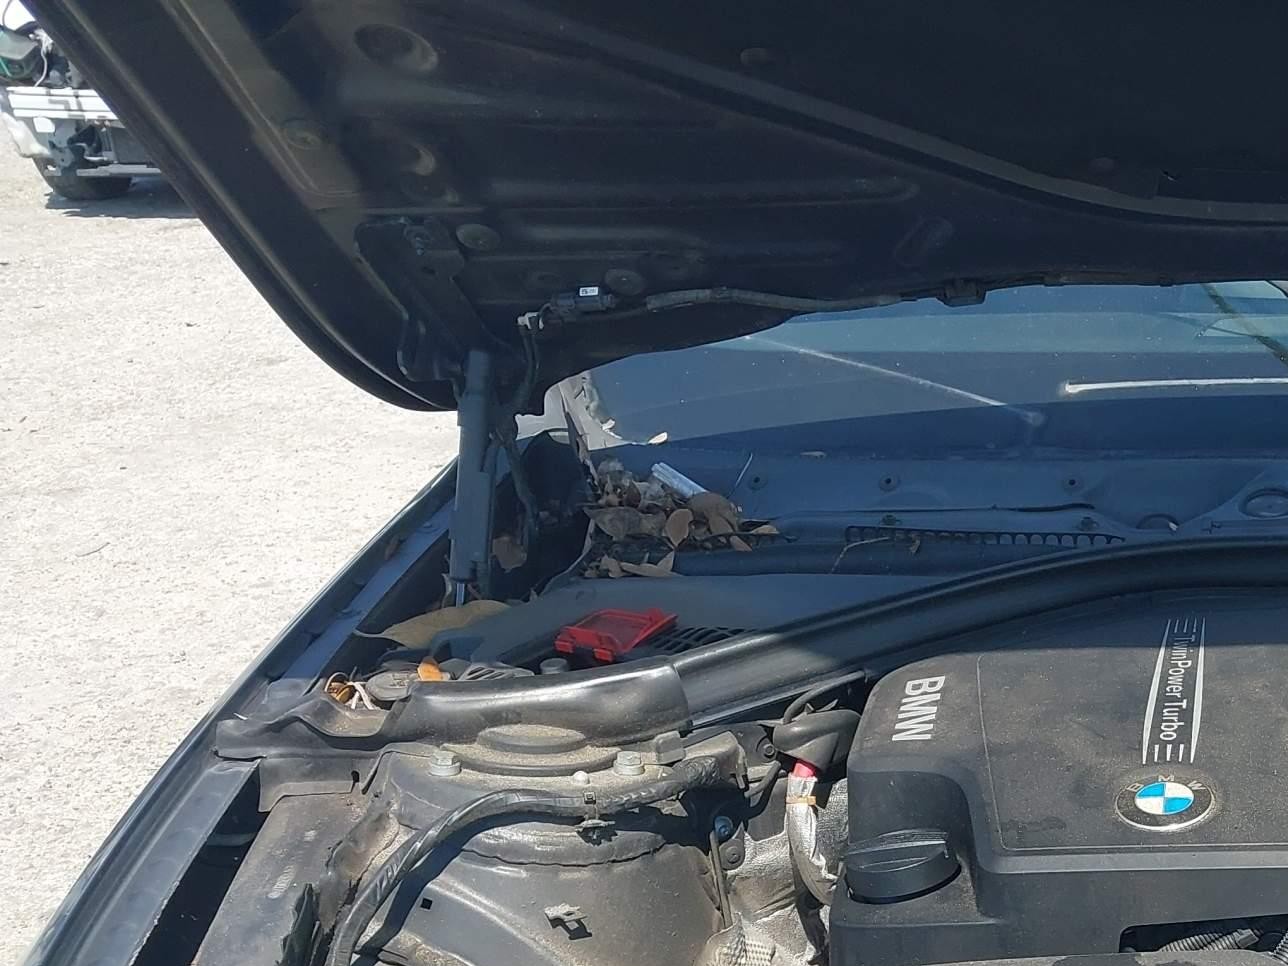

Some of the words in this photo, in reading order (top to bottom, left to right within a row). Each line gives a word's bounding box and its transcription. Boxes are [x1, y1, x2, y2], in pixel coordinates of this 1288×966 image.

[1164, 634, 1196, 699] TwinPower
[891, 675, 946, 741] BMW
[1159, 699, 1187, 741] Turbo
[1126, 774, 1207, 793] BMW
